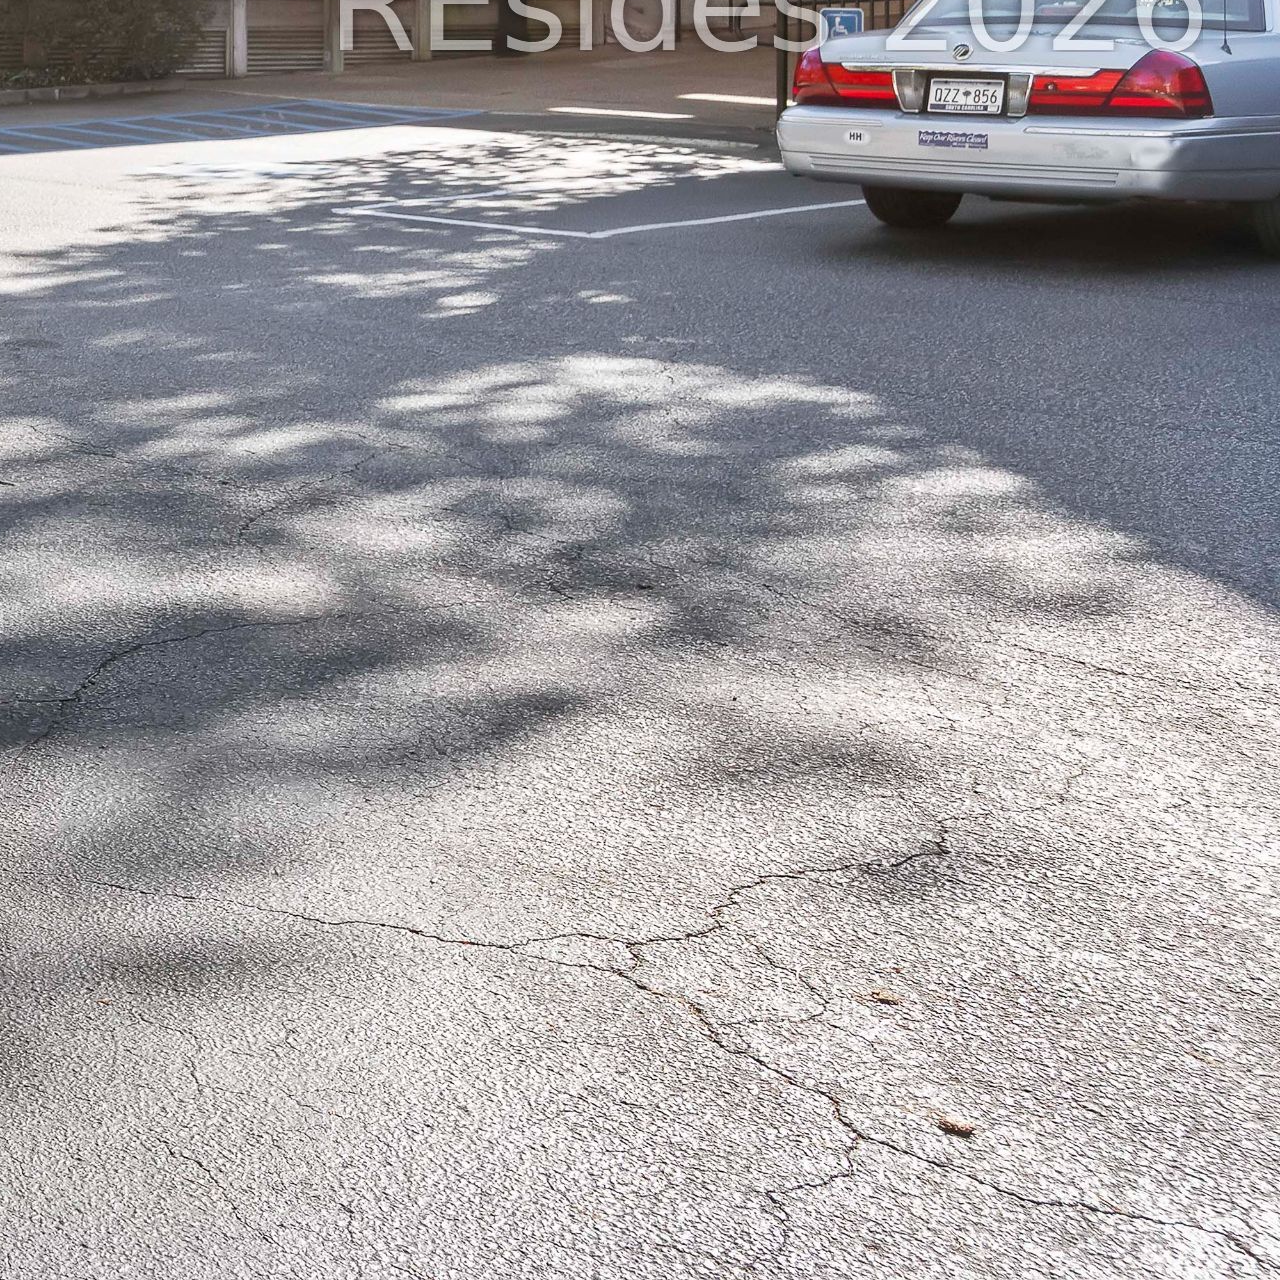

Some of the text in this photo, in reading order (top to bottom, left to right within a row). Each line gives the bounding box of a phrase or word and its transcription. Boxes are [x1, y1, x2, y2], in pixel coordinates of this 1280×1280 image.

[934, 88, 998, 104] QZZ 856
[849, 131, 862, 141] HH
